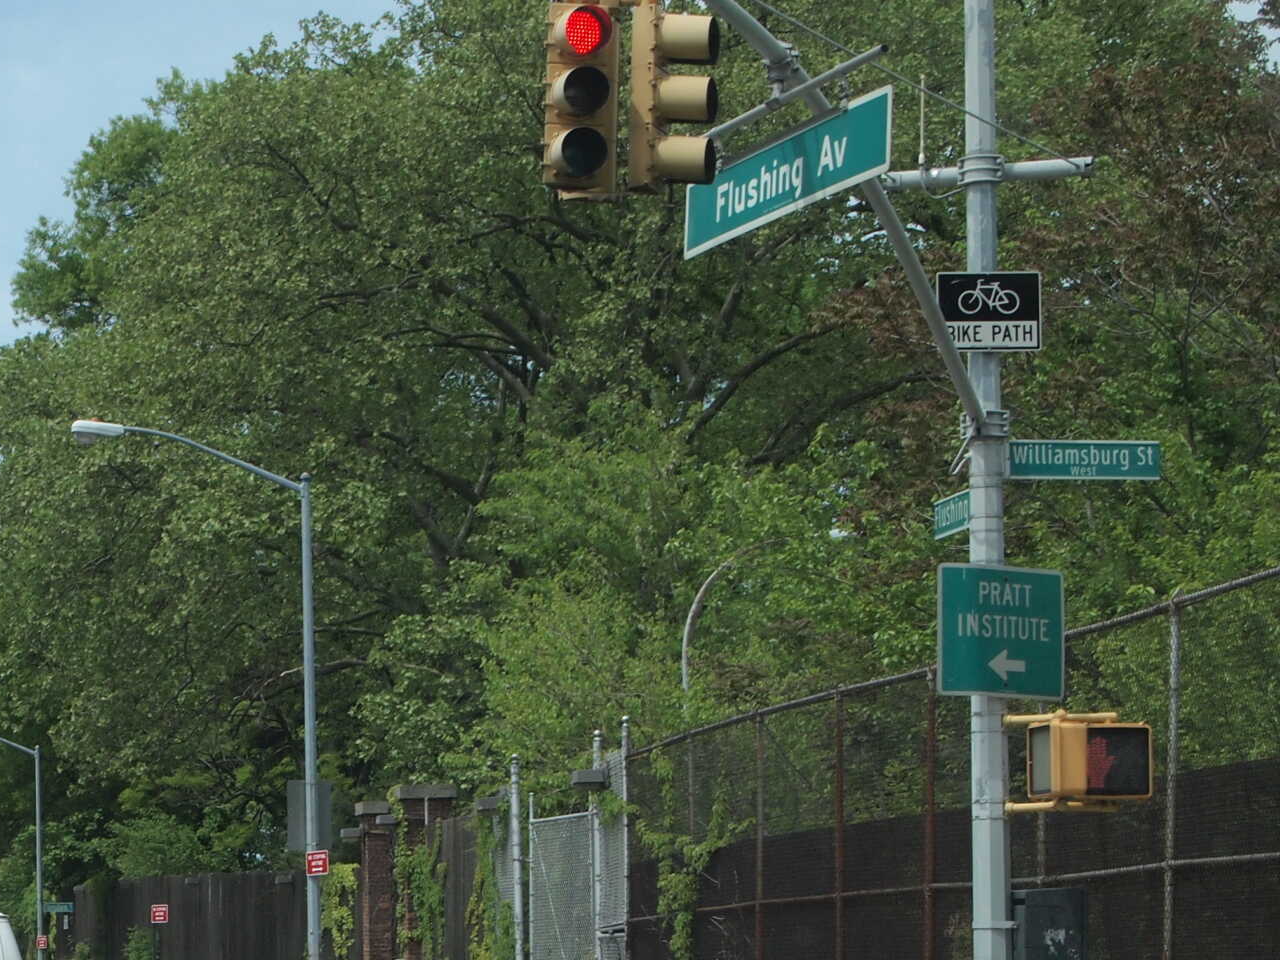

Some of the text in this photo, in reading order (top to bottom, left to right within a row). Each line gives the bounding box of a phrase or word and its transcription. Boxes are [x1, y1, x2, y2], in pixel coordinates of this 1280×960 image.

[716, 134, 848, 223] Flushing Av
[991, 324, 1033, 342] PATH
[1013, 443, 1153, 471] Williamsburg St
[1070, 465, 1097, 477] West
[978, 581, 1033, 608] PRATT
[957, 612, 1050, 642] INSTITUTE
